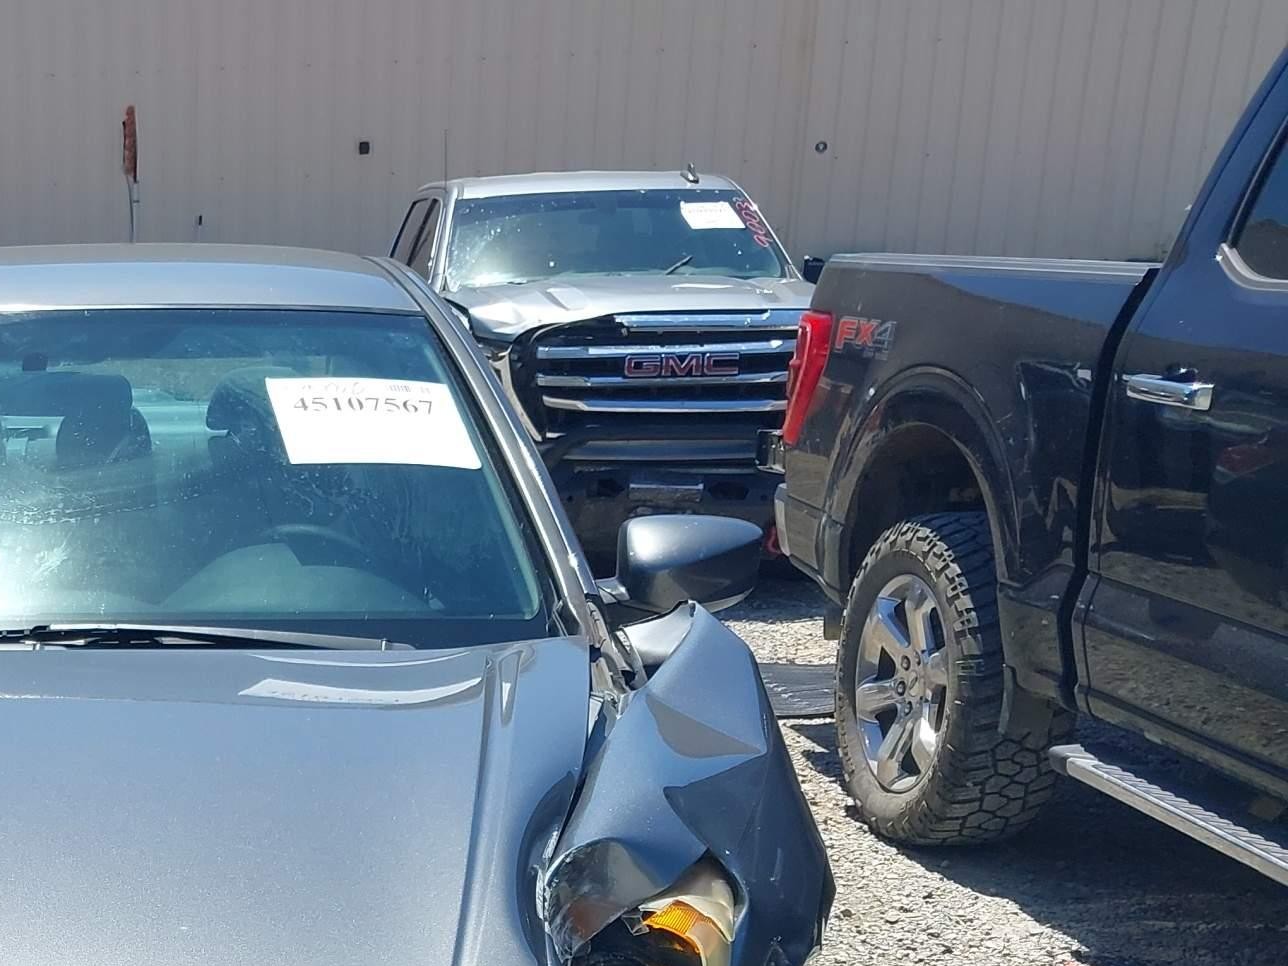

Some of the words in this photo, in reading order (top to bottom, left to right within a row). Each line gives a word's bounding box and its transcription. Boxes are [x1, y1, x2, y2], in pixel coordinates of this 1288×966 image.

[834, 315, 897, 353] FX4
[624, 353, 740, 377] GMC
[293, 397, 433, 415] 45107567
